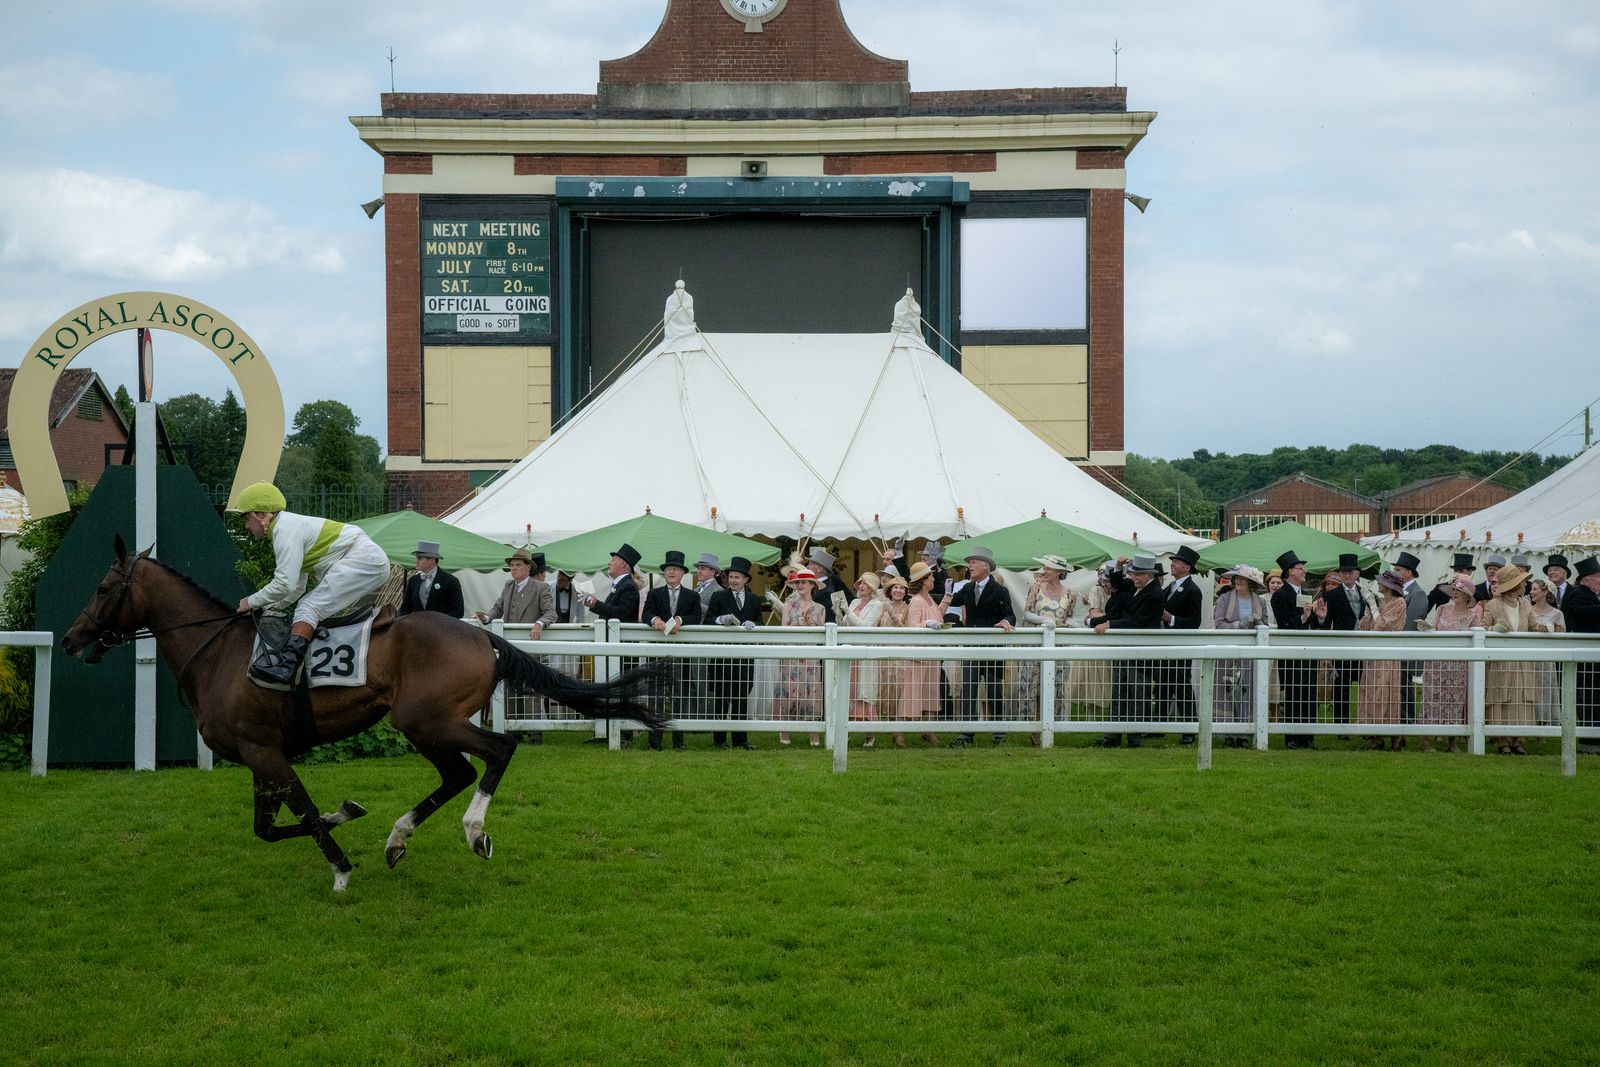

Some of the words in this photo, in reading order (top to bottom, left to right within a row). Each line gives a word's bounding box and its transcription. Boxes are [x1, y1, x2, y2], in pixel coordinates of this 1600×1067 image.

[433, 223, 468, 237] NEXT
[479, 223, 541, 237] MEETING
[426, 242, 483, 255] MONDAY
[437, 260, 472, 274] JULY
[441, 279, 472, 293] SAT.
[428, 298, 491, 311] OFFICIAL
[505, 298, 547, 311] GOING
[459, 318, 480, 328] GOOD
[497, 318, 517, 328] SOFT
[35, 301, 138, 370] ROYAL
[147, 300, 255, 366] ASCOT
[310, 644, 355, 677] 23
